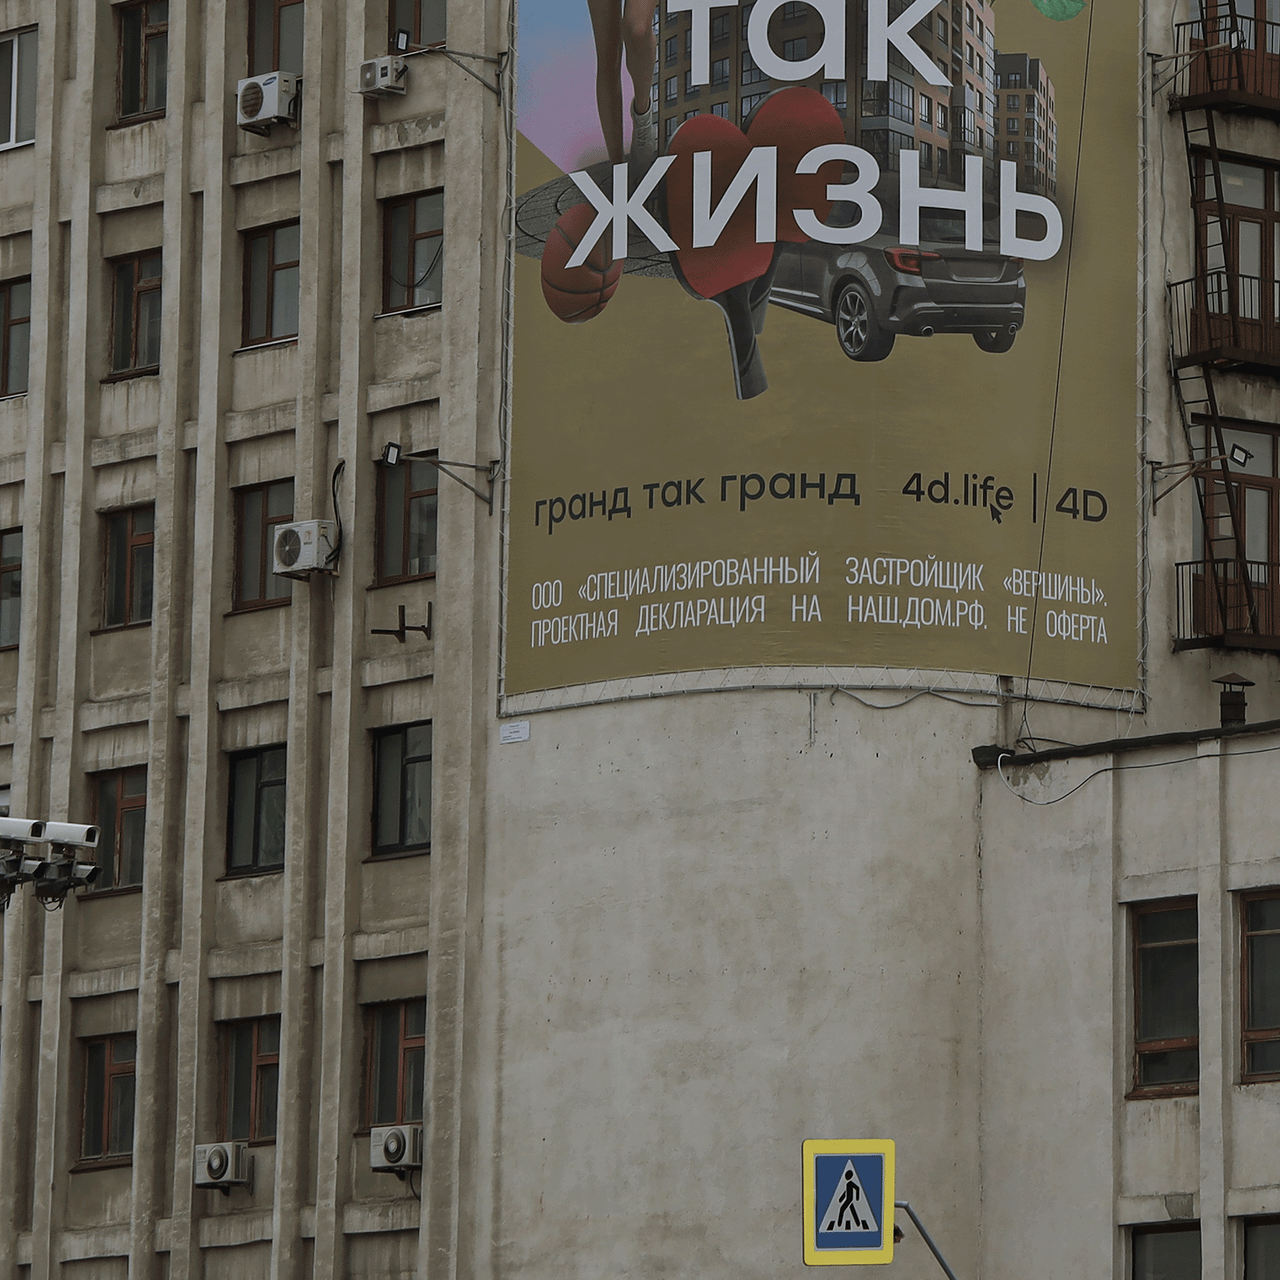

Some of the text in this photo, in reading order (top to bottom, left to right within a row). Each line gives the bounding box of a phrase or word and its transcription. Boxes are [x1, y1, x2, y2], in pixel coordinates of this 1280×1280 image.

[564, 143, 1064, 270] жизнь
[534, 471, 861, 536] гранд так гранд
[902, 471, 1109, 523] 4d.life 4D
[531, 550, 1108, 611] ООО «СПЕЦИАЛИЗИРОВАННЫЙ ЗАСТРОЙЩИК «ВЕРШИНЫ».
[529, 594, 1109, 649] ПРОЕКТНАЯ ДЕКЛАРАЦИЯ НА НАШ.ДОМ.РФ. НЕ ОФЕРТА
